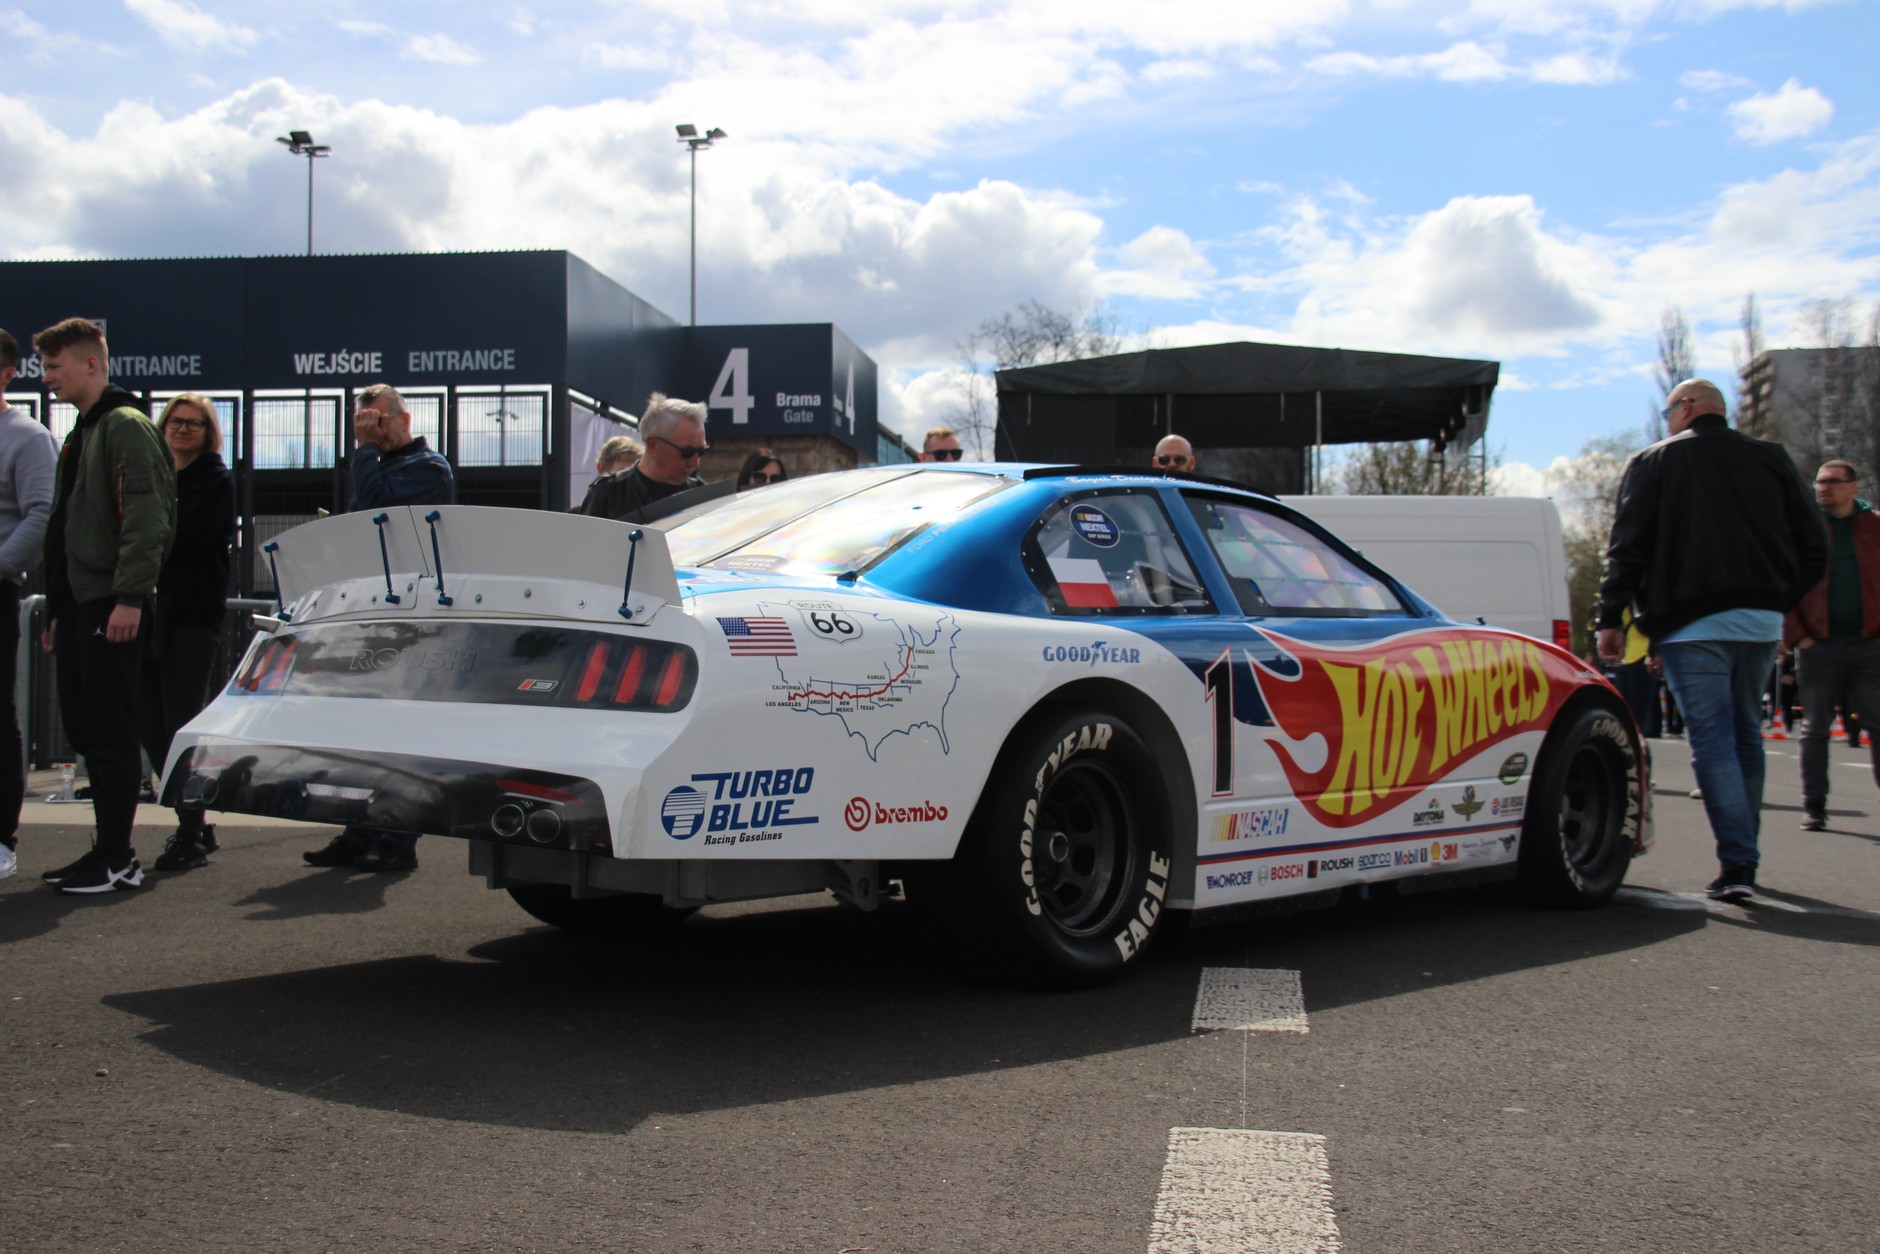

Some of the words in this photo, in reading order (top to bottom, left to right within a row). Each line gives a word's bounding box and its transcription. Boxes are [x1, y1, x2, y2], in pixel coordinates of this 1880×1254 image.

[109, 355, 201, 376] NTRANCE
[294, 349, 382, 374] WEJŚCIE
[408, 350, 515, 372] ENTRANCE
[709, 348, 755, 424] 4
[776, 392, 822, 407] Brama
[845, 362, 855, 436] 4
[783, 409, 814, 423] Gate
[1079, 522, 1111, 533] NEXTEL
[906, 536, 935, 554] FORD
[797, 601, 834, 610] ROUTE
[811, 611, 854, 635] 66
[349, 648, 477, 672] ROUSH
[1204, 647, 1234, 797] 1
[1316, 656, 1425, 815] HOT
[691, 767, 815, 801] TURBO
[707, 799, 819, 832] BLUE
[875, 801, 949, 825] brembo
[1230, 809, 1289, 840] NASCAR
[1413, 810, 1444, 823] DAYTONA
[704, 833, 737, 846] Racing
[739, 831, 783, 843] Gasolines
[1206, 871, 1253, 889] MONROE
[1270, 864, 1304, 880] BOSCH
[1320, 857, 1354, 871] ROUSH
[1358, 852, 1392, 867] sparco
[1394, 849, 1419, 866] Mobil
[1442, 843, 1458, 862] 3M
[1114, 850, 1170, 962] EAGLE
